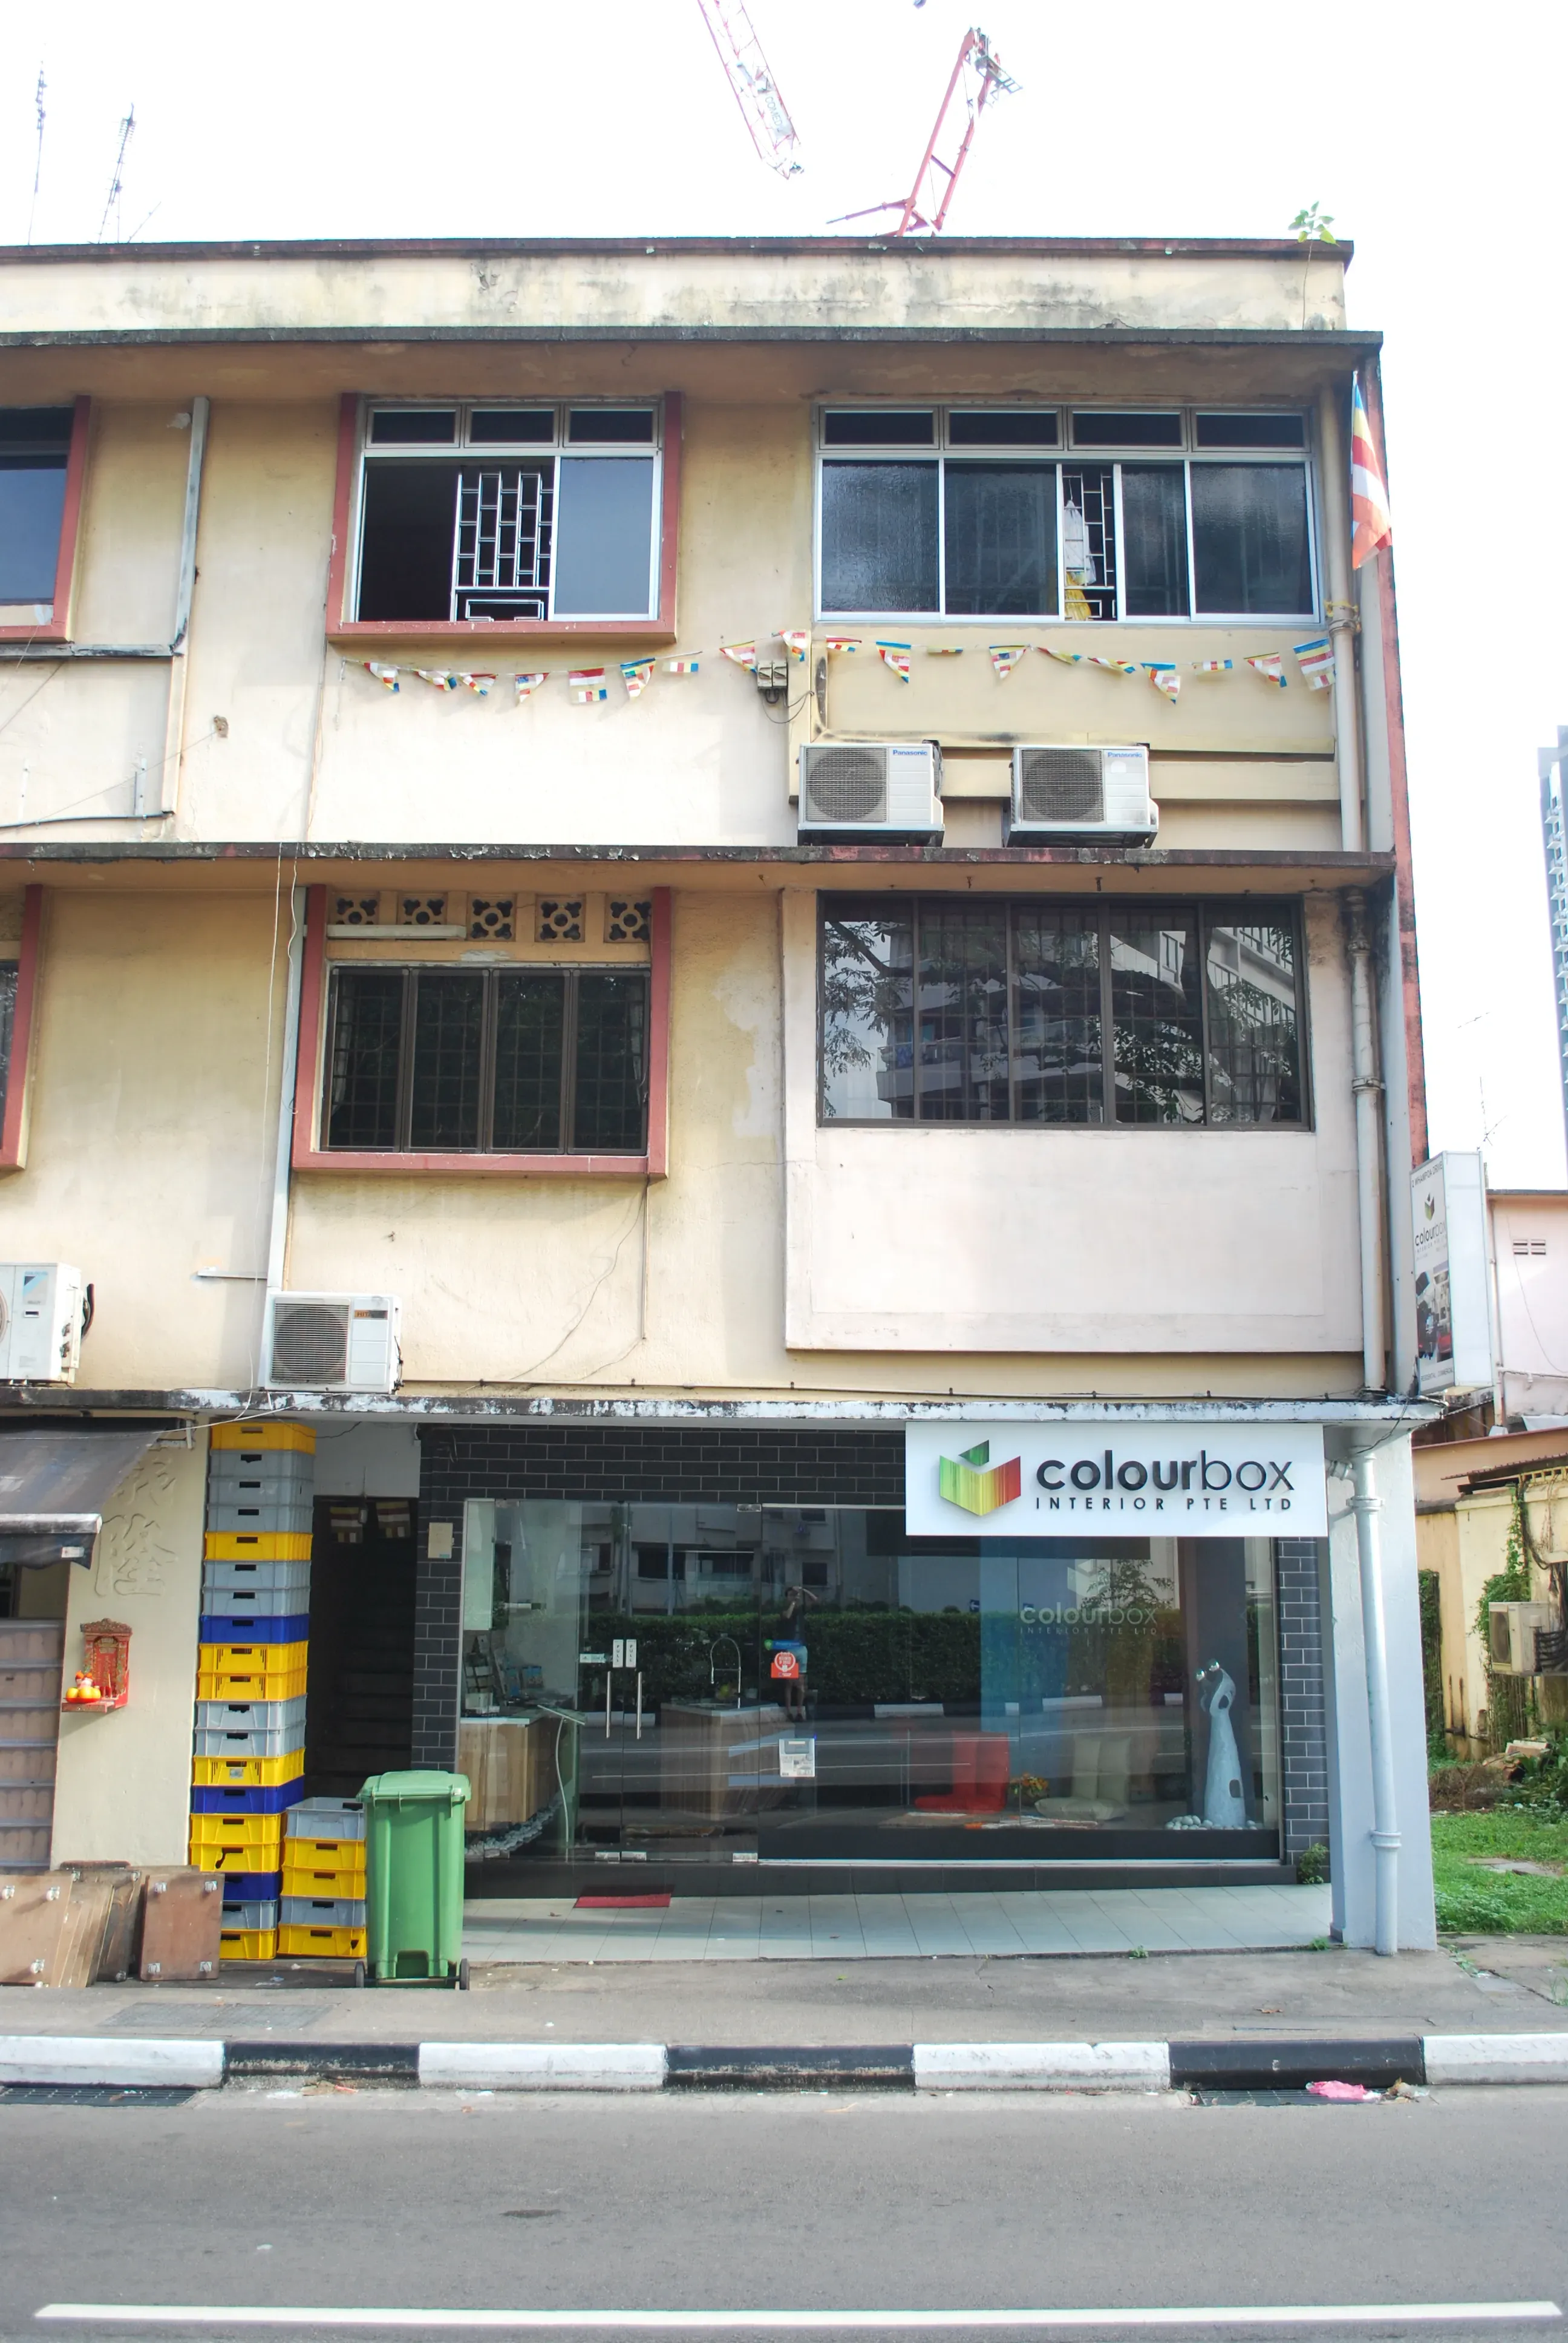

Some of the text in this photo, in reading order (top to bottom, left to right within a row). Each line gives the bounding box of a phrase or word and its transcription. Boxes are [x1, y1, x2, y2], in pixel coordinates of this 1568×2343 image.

[1036, 1450, 1295, 1491] colourbox
[1036, 1497, 1292, 1510] INTERIOR PTE LTD
[1020, 1602, 1158, 1626] colourbox
